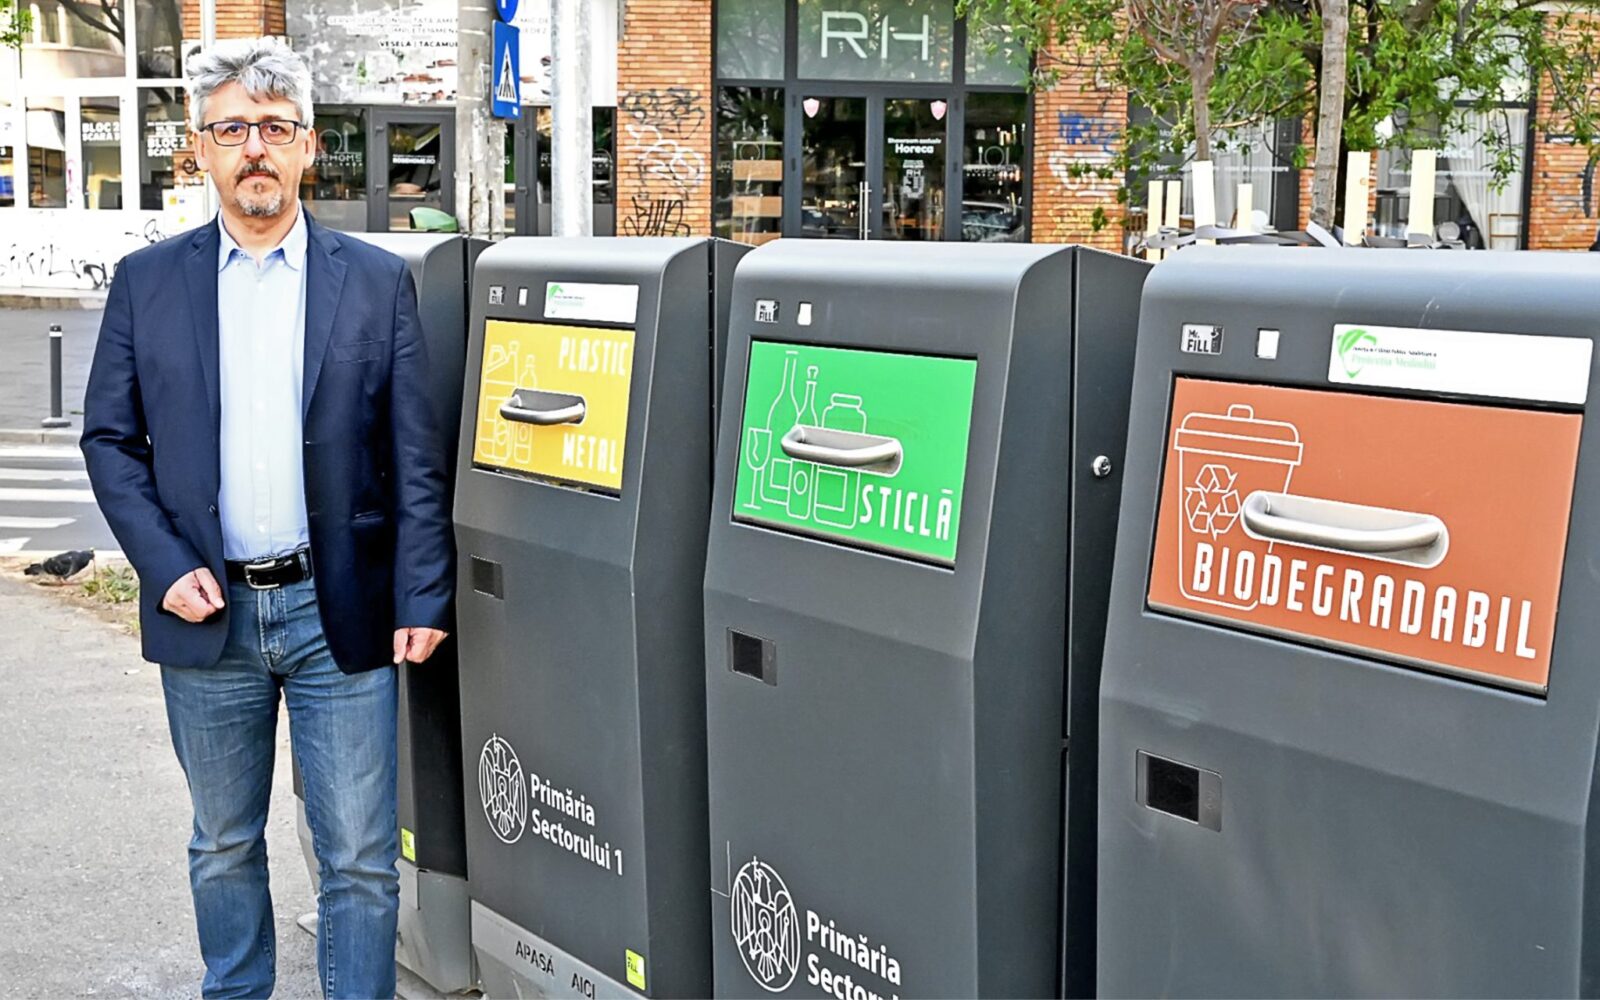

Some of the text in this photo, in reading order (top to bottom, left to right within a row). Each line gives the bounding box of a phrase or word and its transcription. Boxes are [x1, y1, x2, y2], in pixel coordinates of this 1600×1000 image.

[821, 10, 929, 61] RH
[895, 143, 934, 154] Horeca
[559, 336, 629, 377] PLASTIC
[1187, 339, 1209, 353] FILL
[562, 432, 619, 475] METAL
[1191, 542, 1537, 660] BIODEGRADABIL
[530, 772, 596, 827] Primăria
[531, 808, 623, 876] Sectorului 1
[806, 910, 901, 986] Primăria
[571, 972, 596, 1000] AICI
